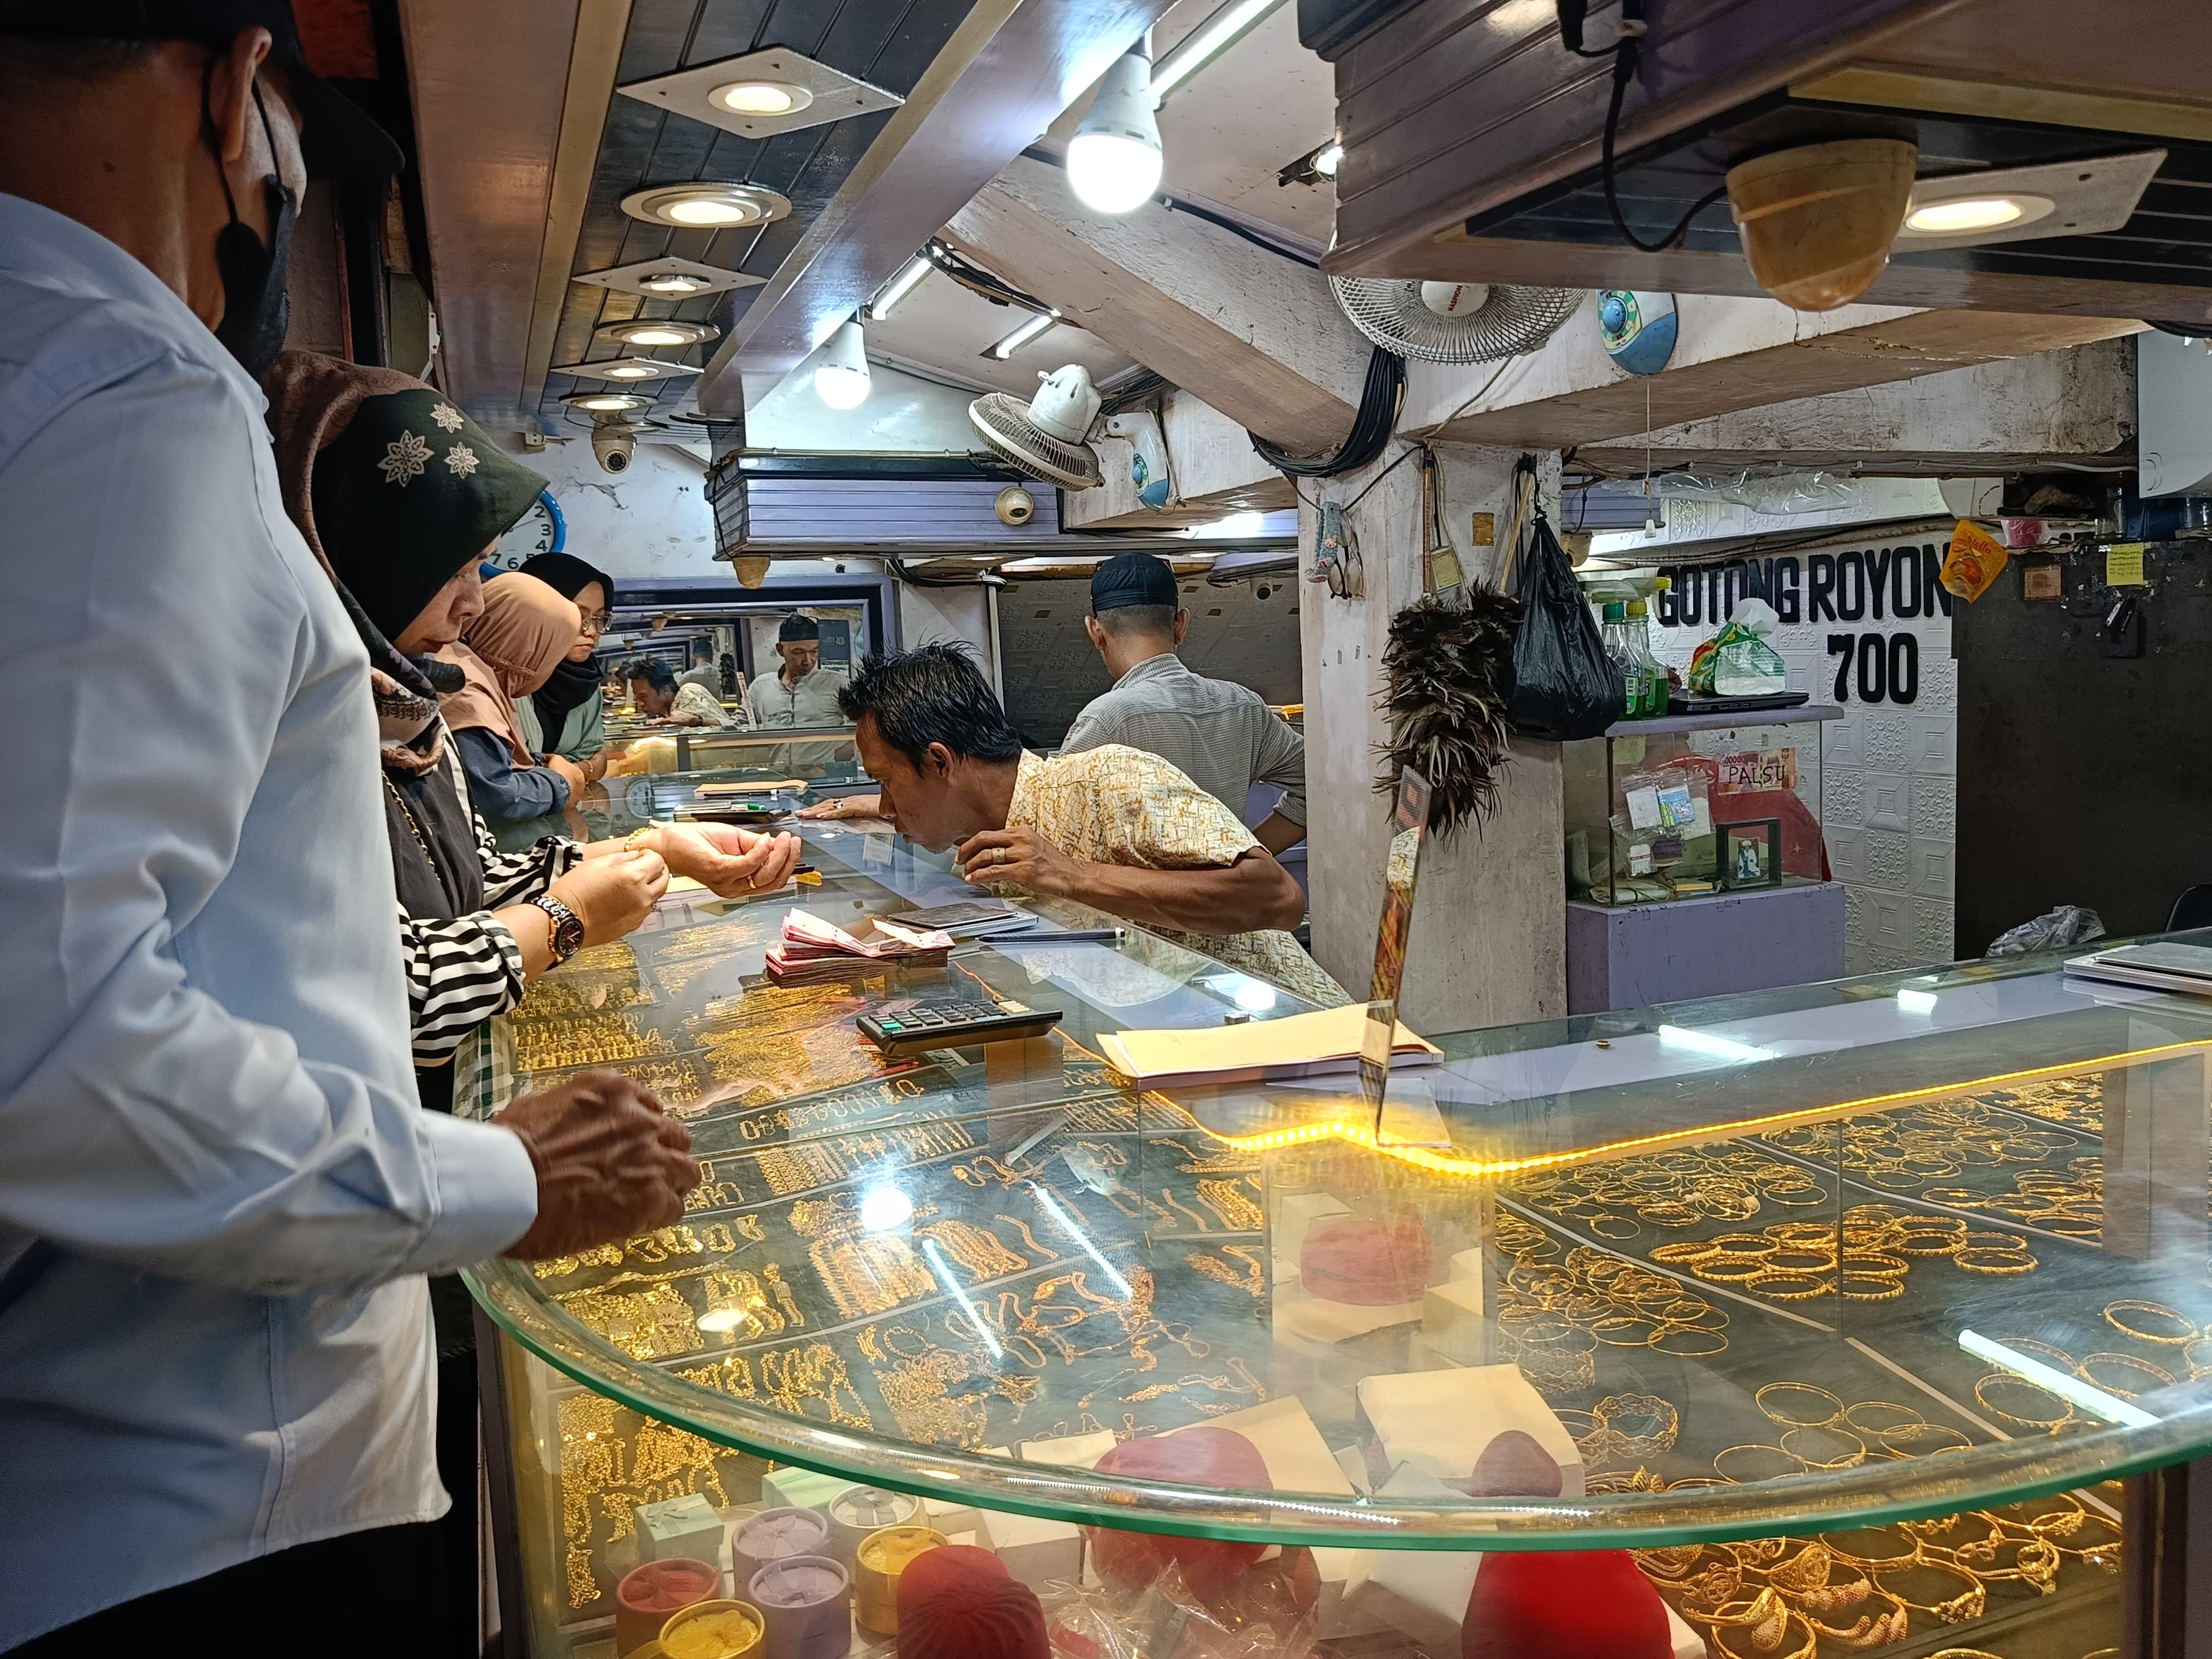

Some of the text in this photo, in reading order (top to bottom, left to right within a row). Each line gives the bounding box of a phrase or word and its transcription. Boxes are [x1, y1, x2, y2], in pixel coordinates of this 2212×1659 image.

[534, 506, 545, 518] 2
[541, 524, 551, 536] 3
[535, 540, 547, 551] 4
[508, 557, 519, 569] 6
[1657, 557, 1799, 625] GOTONG
[1827, 633, 1918, 705] 700
[1728, 765, 1785, 784] PALSU
